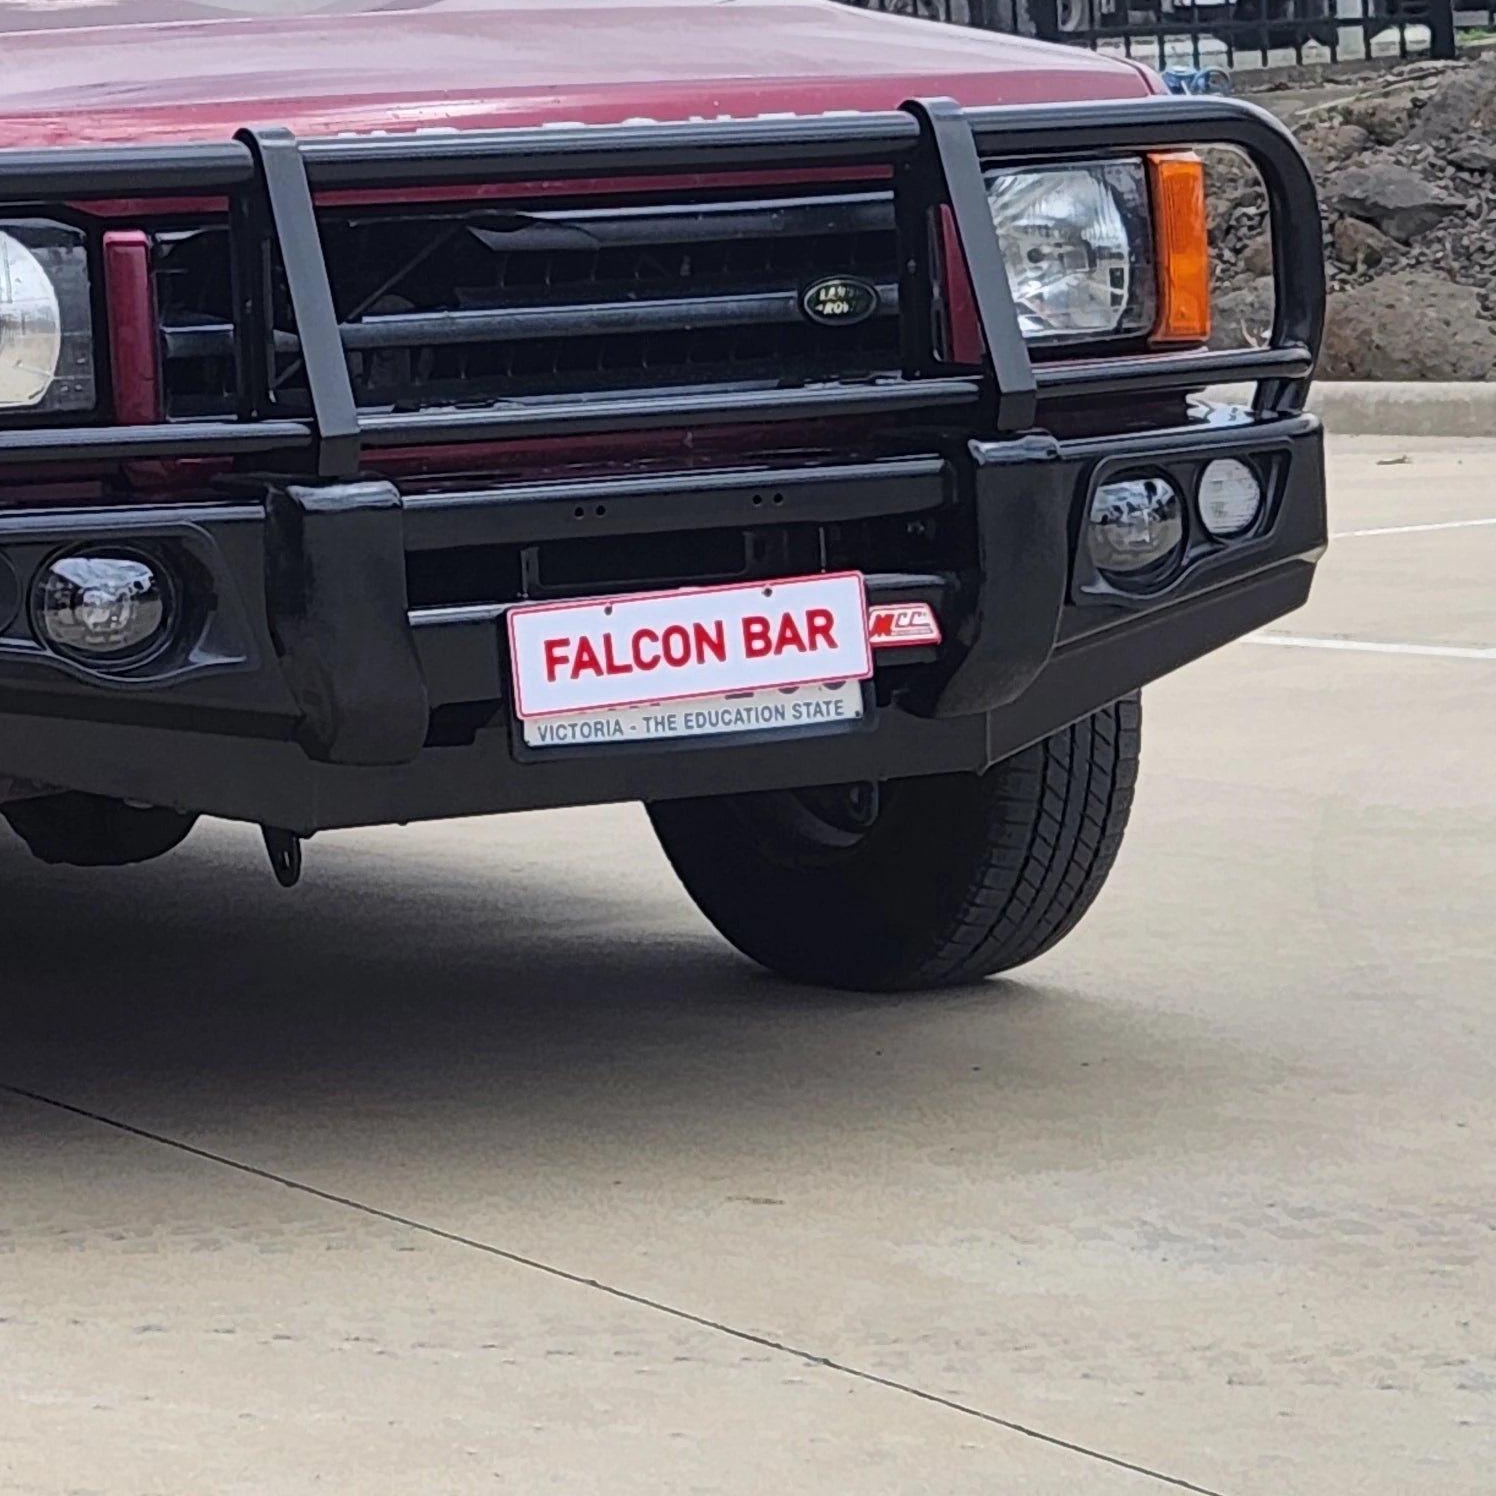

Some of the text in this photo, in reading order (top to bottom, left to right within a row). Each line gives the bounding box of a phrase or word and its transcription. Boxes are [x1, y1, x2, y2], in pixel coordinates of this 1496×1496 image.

[544, 608, 838, 683] FALCON BAR
[869, 610, 931, 637] MCC
[537, 719, 625, 743] VICTORIA
[642, 713, 678, 734] THE
[684, 705, 786, 730] EDUCATION
[792, 699, 845, 720] STATE
